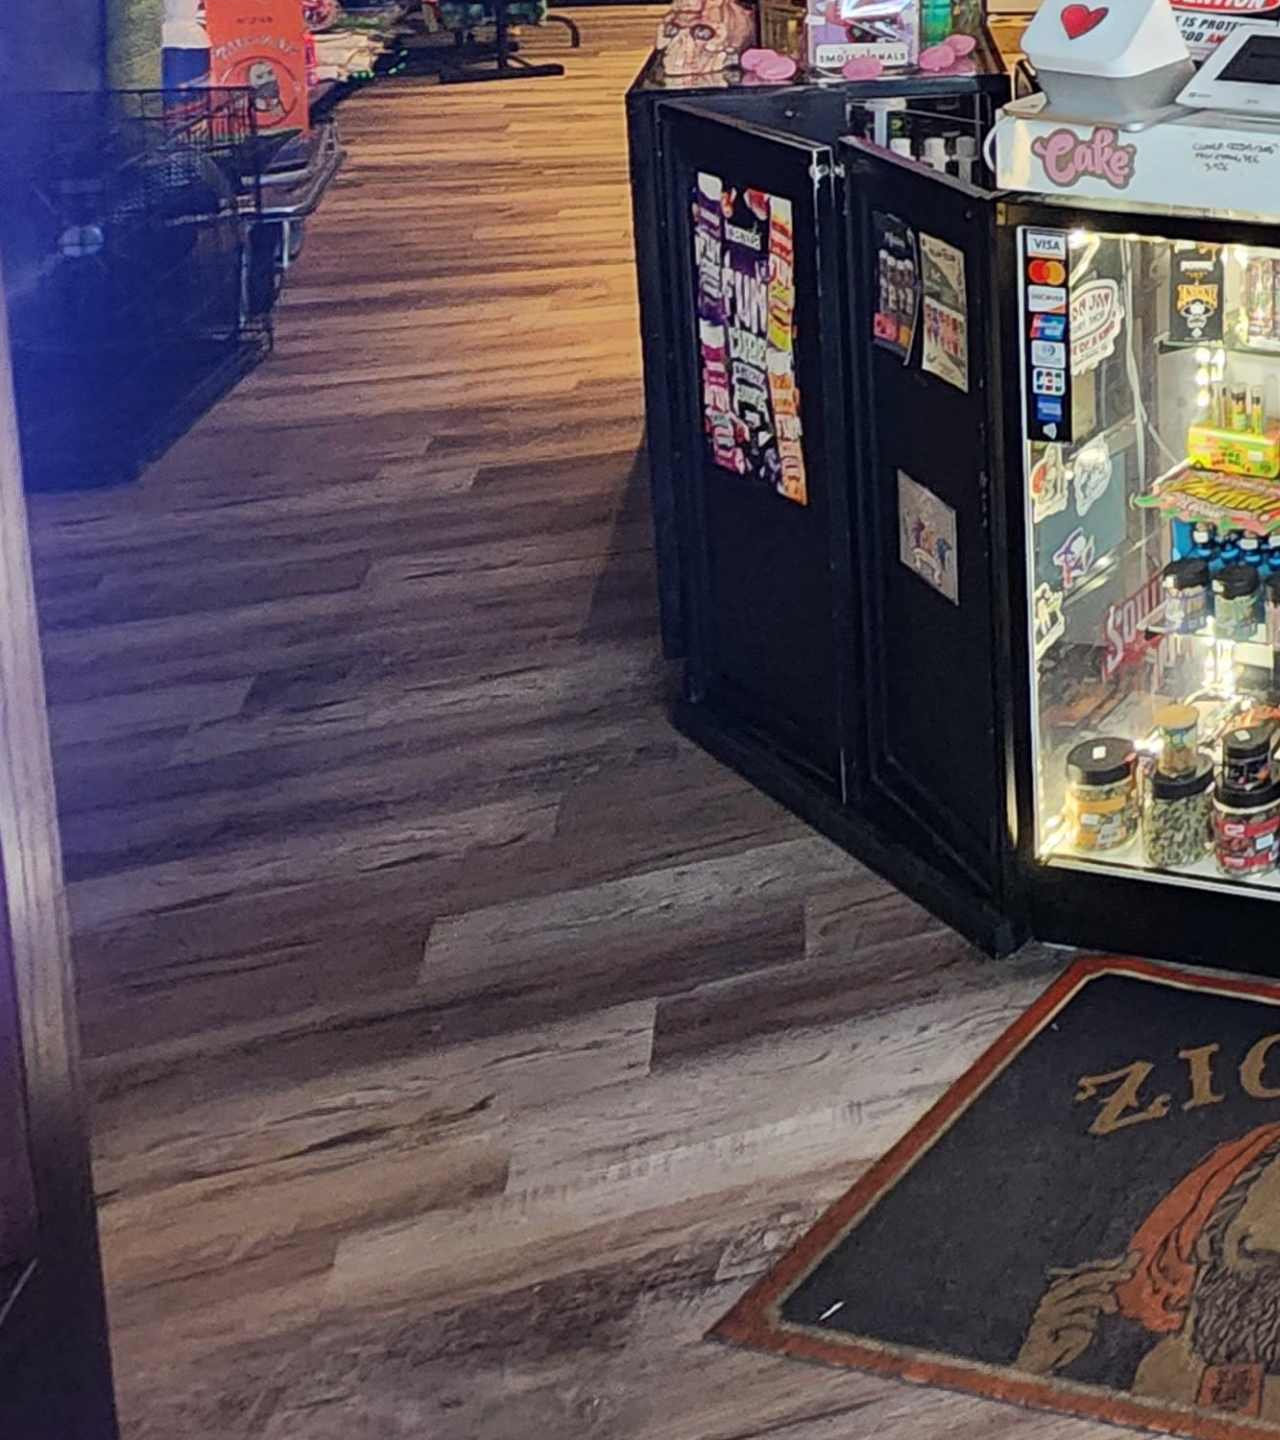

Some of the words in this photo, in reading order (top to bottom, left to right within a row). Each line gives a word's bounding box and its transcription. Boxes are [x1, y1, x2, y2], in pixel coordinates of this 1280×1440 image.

[1181, 16, 1196, 28] IS
[1034, 129, 1134, 187] Cake
[1033, 238, 1061, 251] VISA
